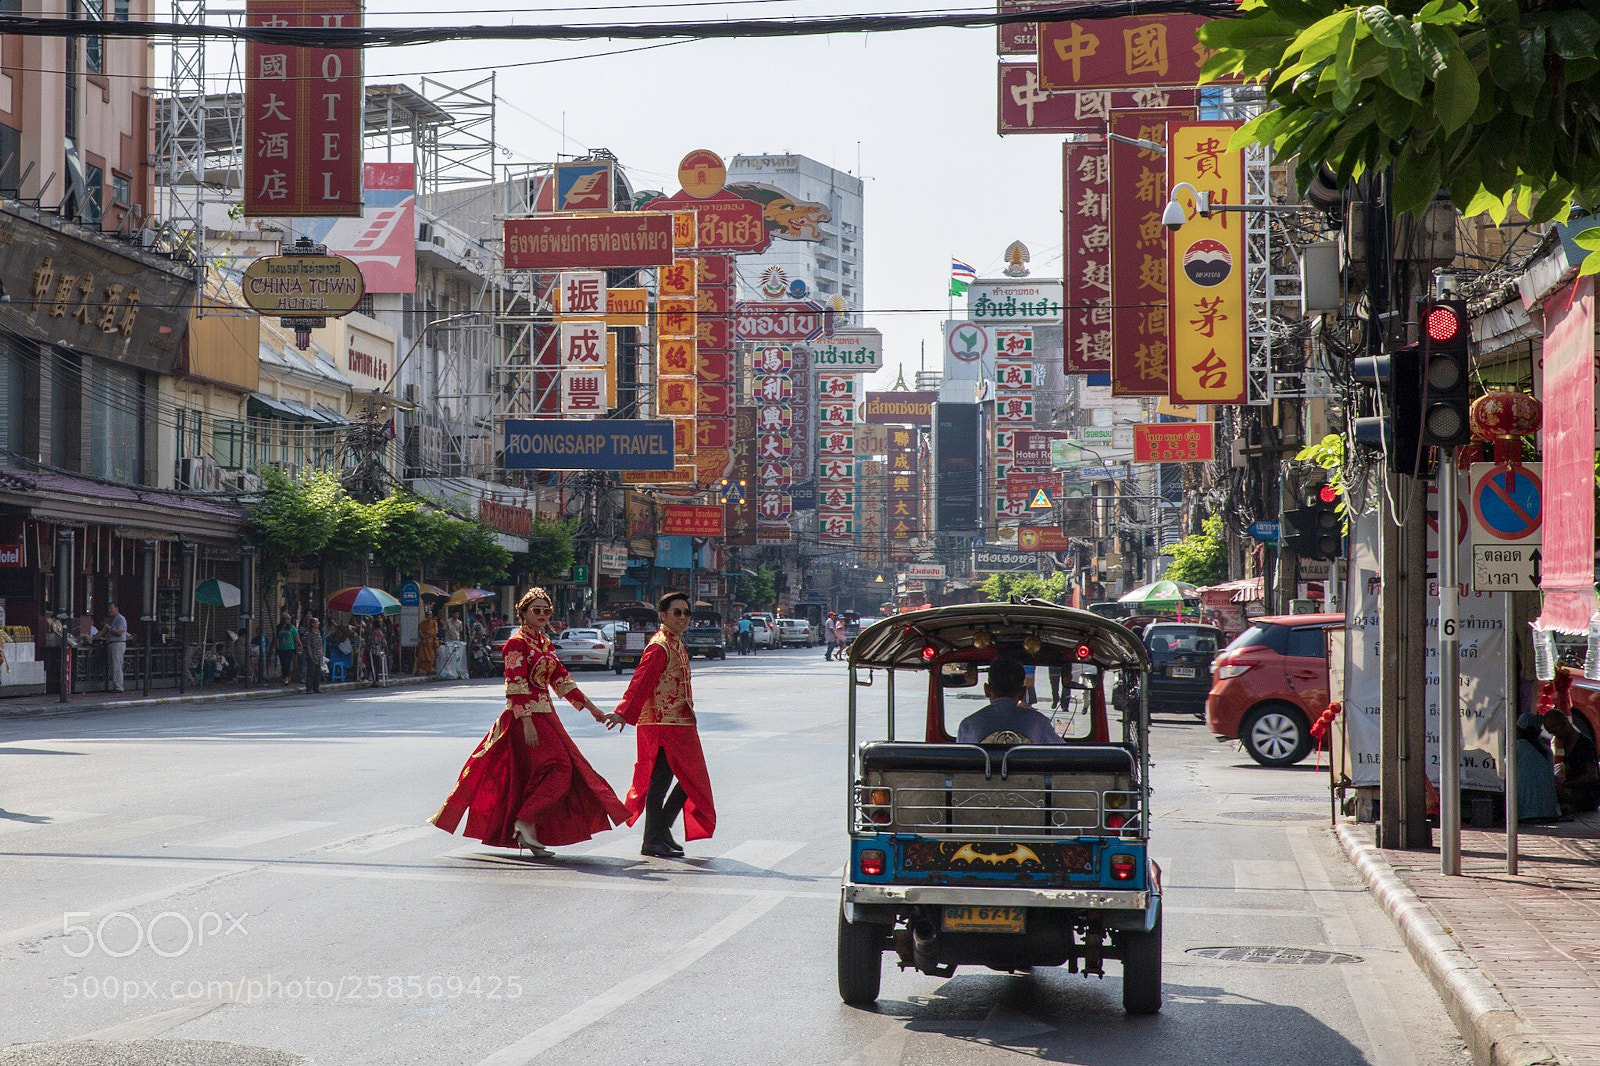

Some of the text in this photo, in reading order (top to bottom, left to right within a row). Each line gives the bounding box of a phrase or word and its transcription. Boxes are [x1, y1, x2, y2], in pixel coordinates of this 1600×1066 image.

[1013, 34, 1037, 45] SHA
[509, 218, 668, 265] รุ่งทรัพย์การท่องเที่ยว
[250, 276, 303, 296] CHINA
[992, 287, 1040, 296] ห้างขายทอง
[277, 297, 329, 310] HOTEL
[509, 434, 668, 455] ROONGSARP TRAVEL
[1016, 450, 1039, 460] Hotel
[735, 442, 749, 536] 北京仁堂
[791, 489, 813, 498] UOB
[0, 548, 19, 563] otel
[1484, 549, 1522, 562] ตลอด
[1487, 571, 1519, 585] เวลา
[1443, 618, 1455, 636] 6
[1459, 757, 1479, 768] .พ.
[978, 908, 1023, 921] 6712
